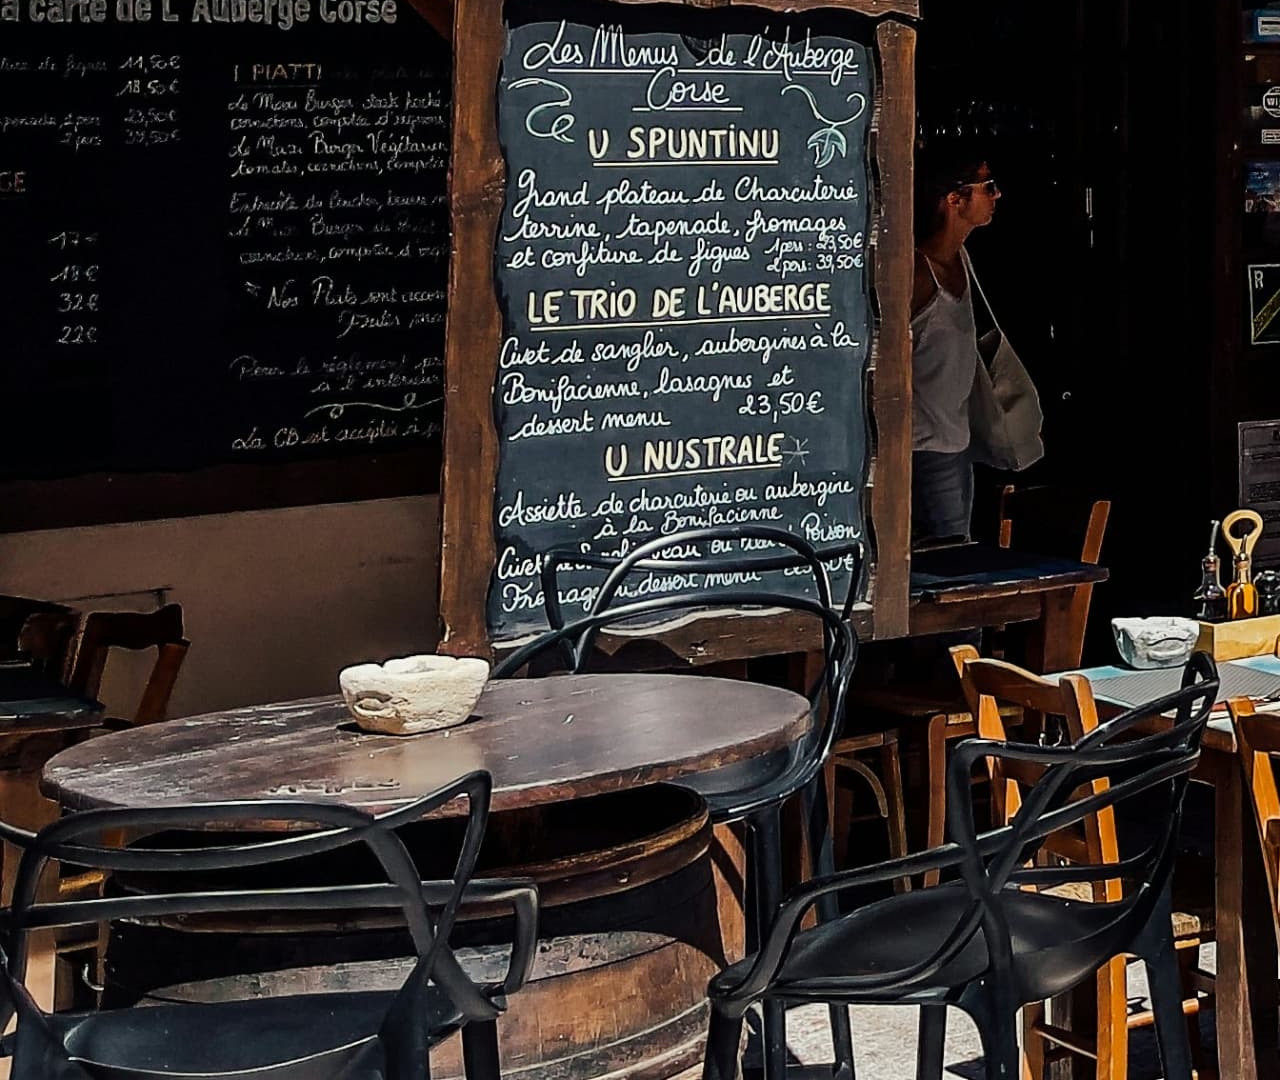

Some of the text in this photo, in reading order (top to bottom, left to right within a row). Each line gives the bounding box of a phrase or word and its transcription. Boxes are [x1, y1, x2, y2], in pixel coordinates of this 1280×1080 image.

[252, 63, 322, 81] PIATTI
[522, 19, 860, 86] Les Menus de l'Auberge
[647, 67, 730, 110] Corse
[588, 128, 610, 159] U
[597, 179, 690, 215] plateau
[690, 179, 725, 204] de
[734, 175, 859, 203] Charcuterie
[503, 209, 847, 245] terrine, tapenade, fromages
[815, 232, 864, 254] 23,50€
[506, 241, 752, 277] et confiture de figues
[815, 254, 864, 275] 39,50€
[528, 290, 564, 324] LE
[652, 287, 686, 318] DE
[697, 281, 832, 315] L'AUBERGE
[500, 320, 861, 372] Civet de sanglier, aubergines à la
[501, 365, 796, 414] Bonifacienne, lasagnes et
[508, 391, 826, 441] dessert menu 23,50€
[604, 432, 785, 477] U NUSTRALE
[499, 471, 856, 527] Assiette de charcuterie ou aubergine
[592, 515, 618, 540] à
[621, 518, 655, 536] la
[638, 571, 699, 598] dessert
